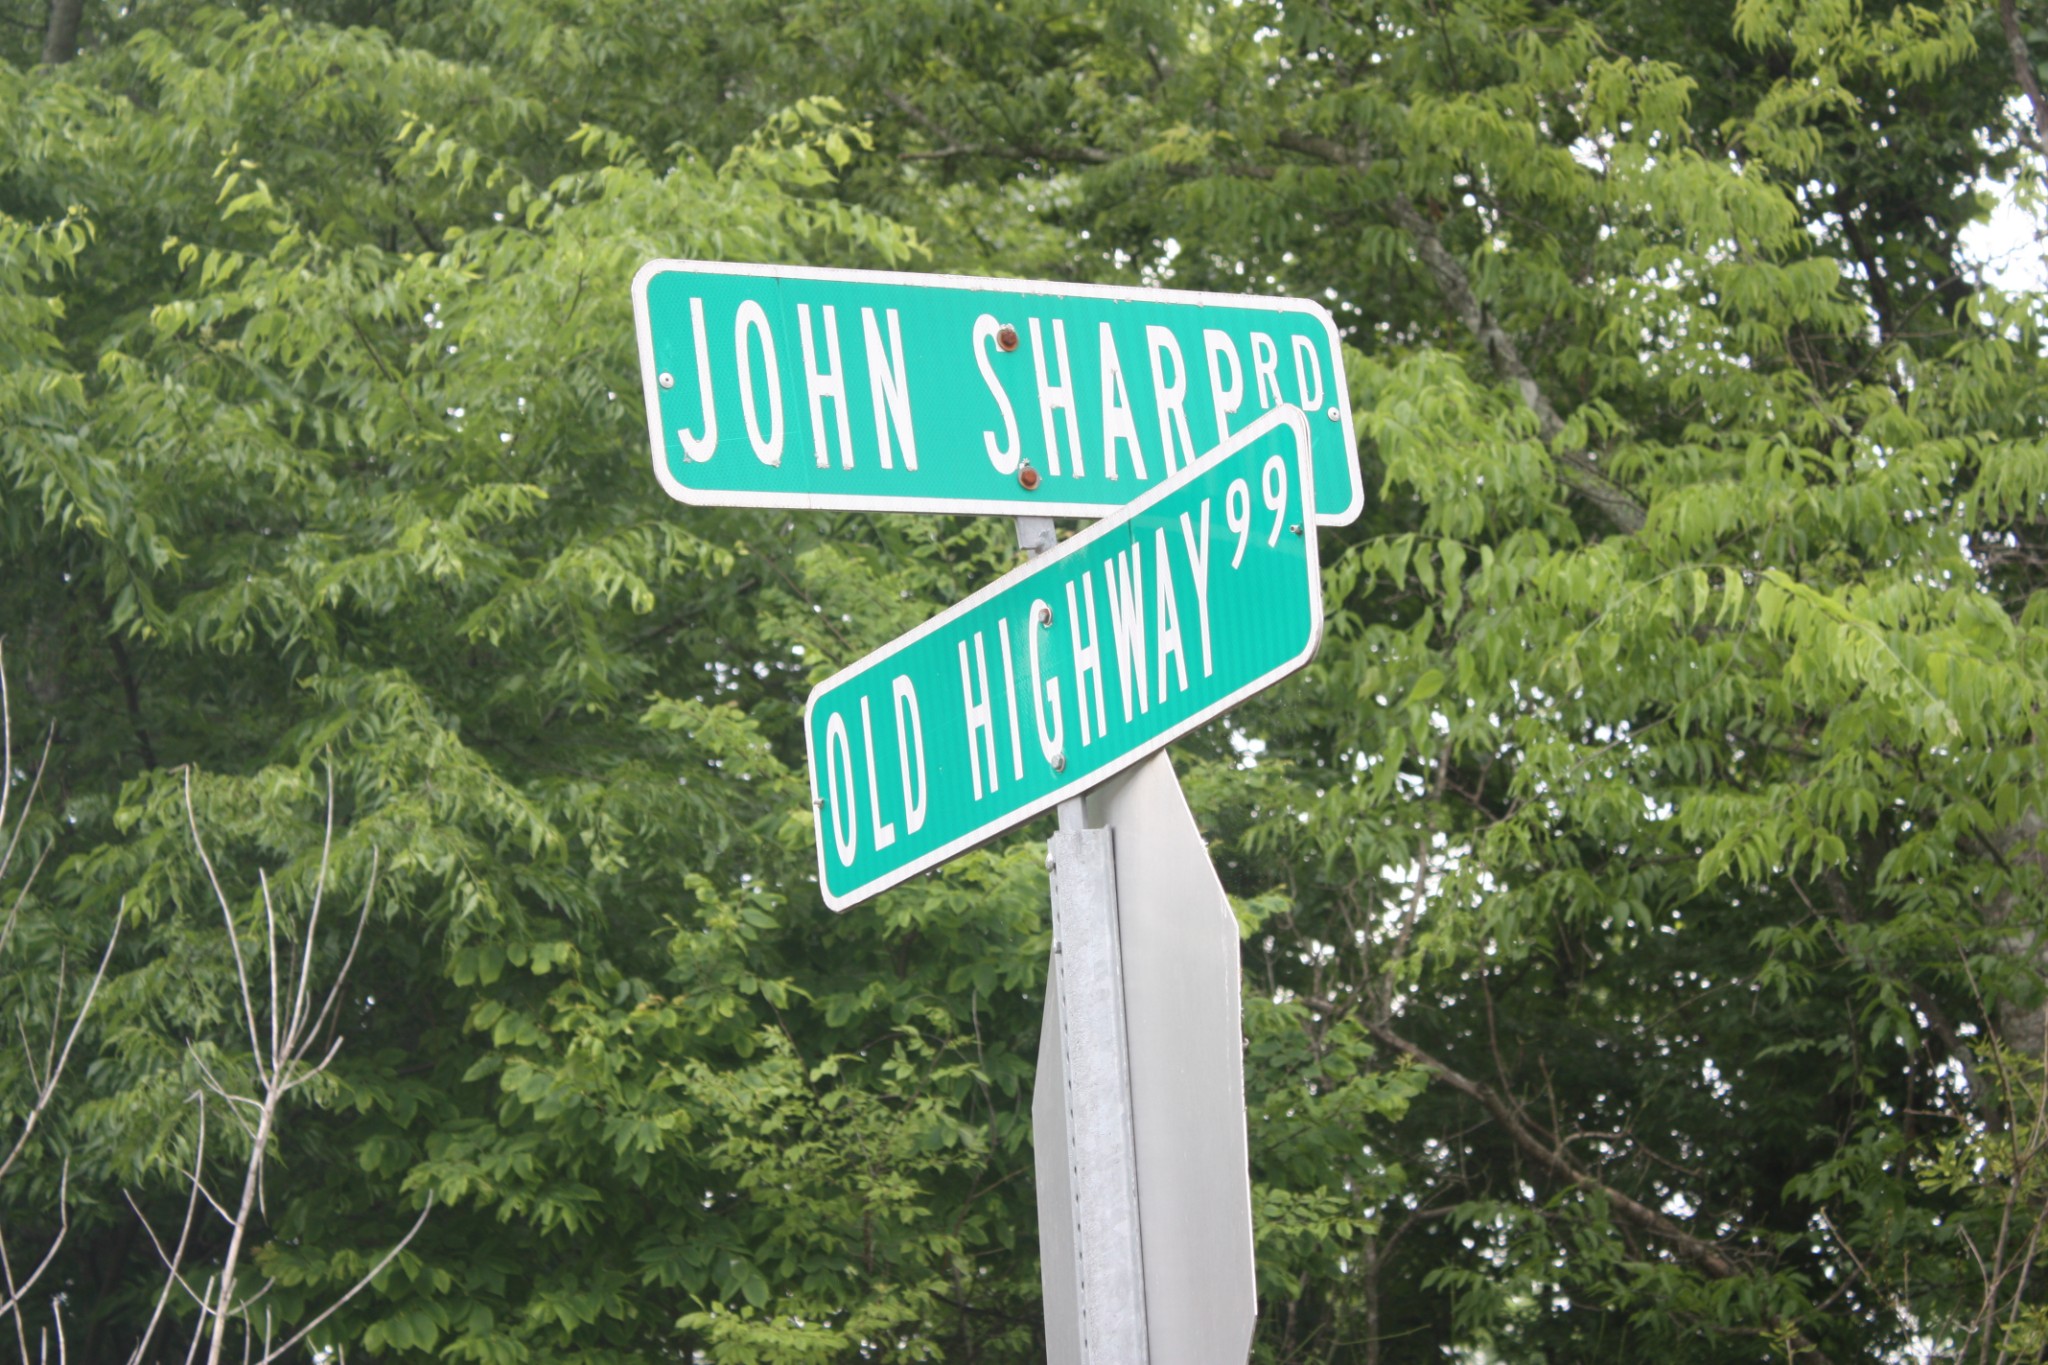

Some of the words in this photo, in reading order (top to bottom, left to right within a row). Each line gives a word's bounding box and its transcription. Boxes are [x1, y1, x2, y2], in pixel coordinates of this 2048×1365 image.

[677, 297, 918, 471] JOHN
[972, 313, 1244, 480] SHARP
[1250, 331, 1324, 412] RD
[826, 674, 927, 868] OLD
[958, 498, 1213, 801] HIGHWAY
[1225, 455, 1288, 570] 99
